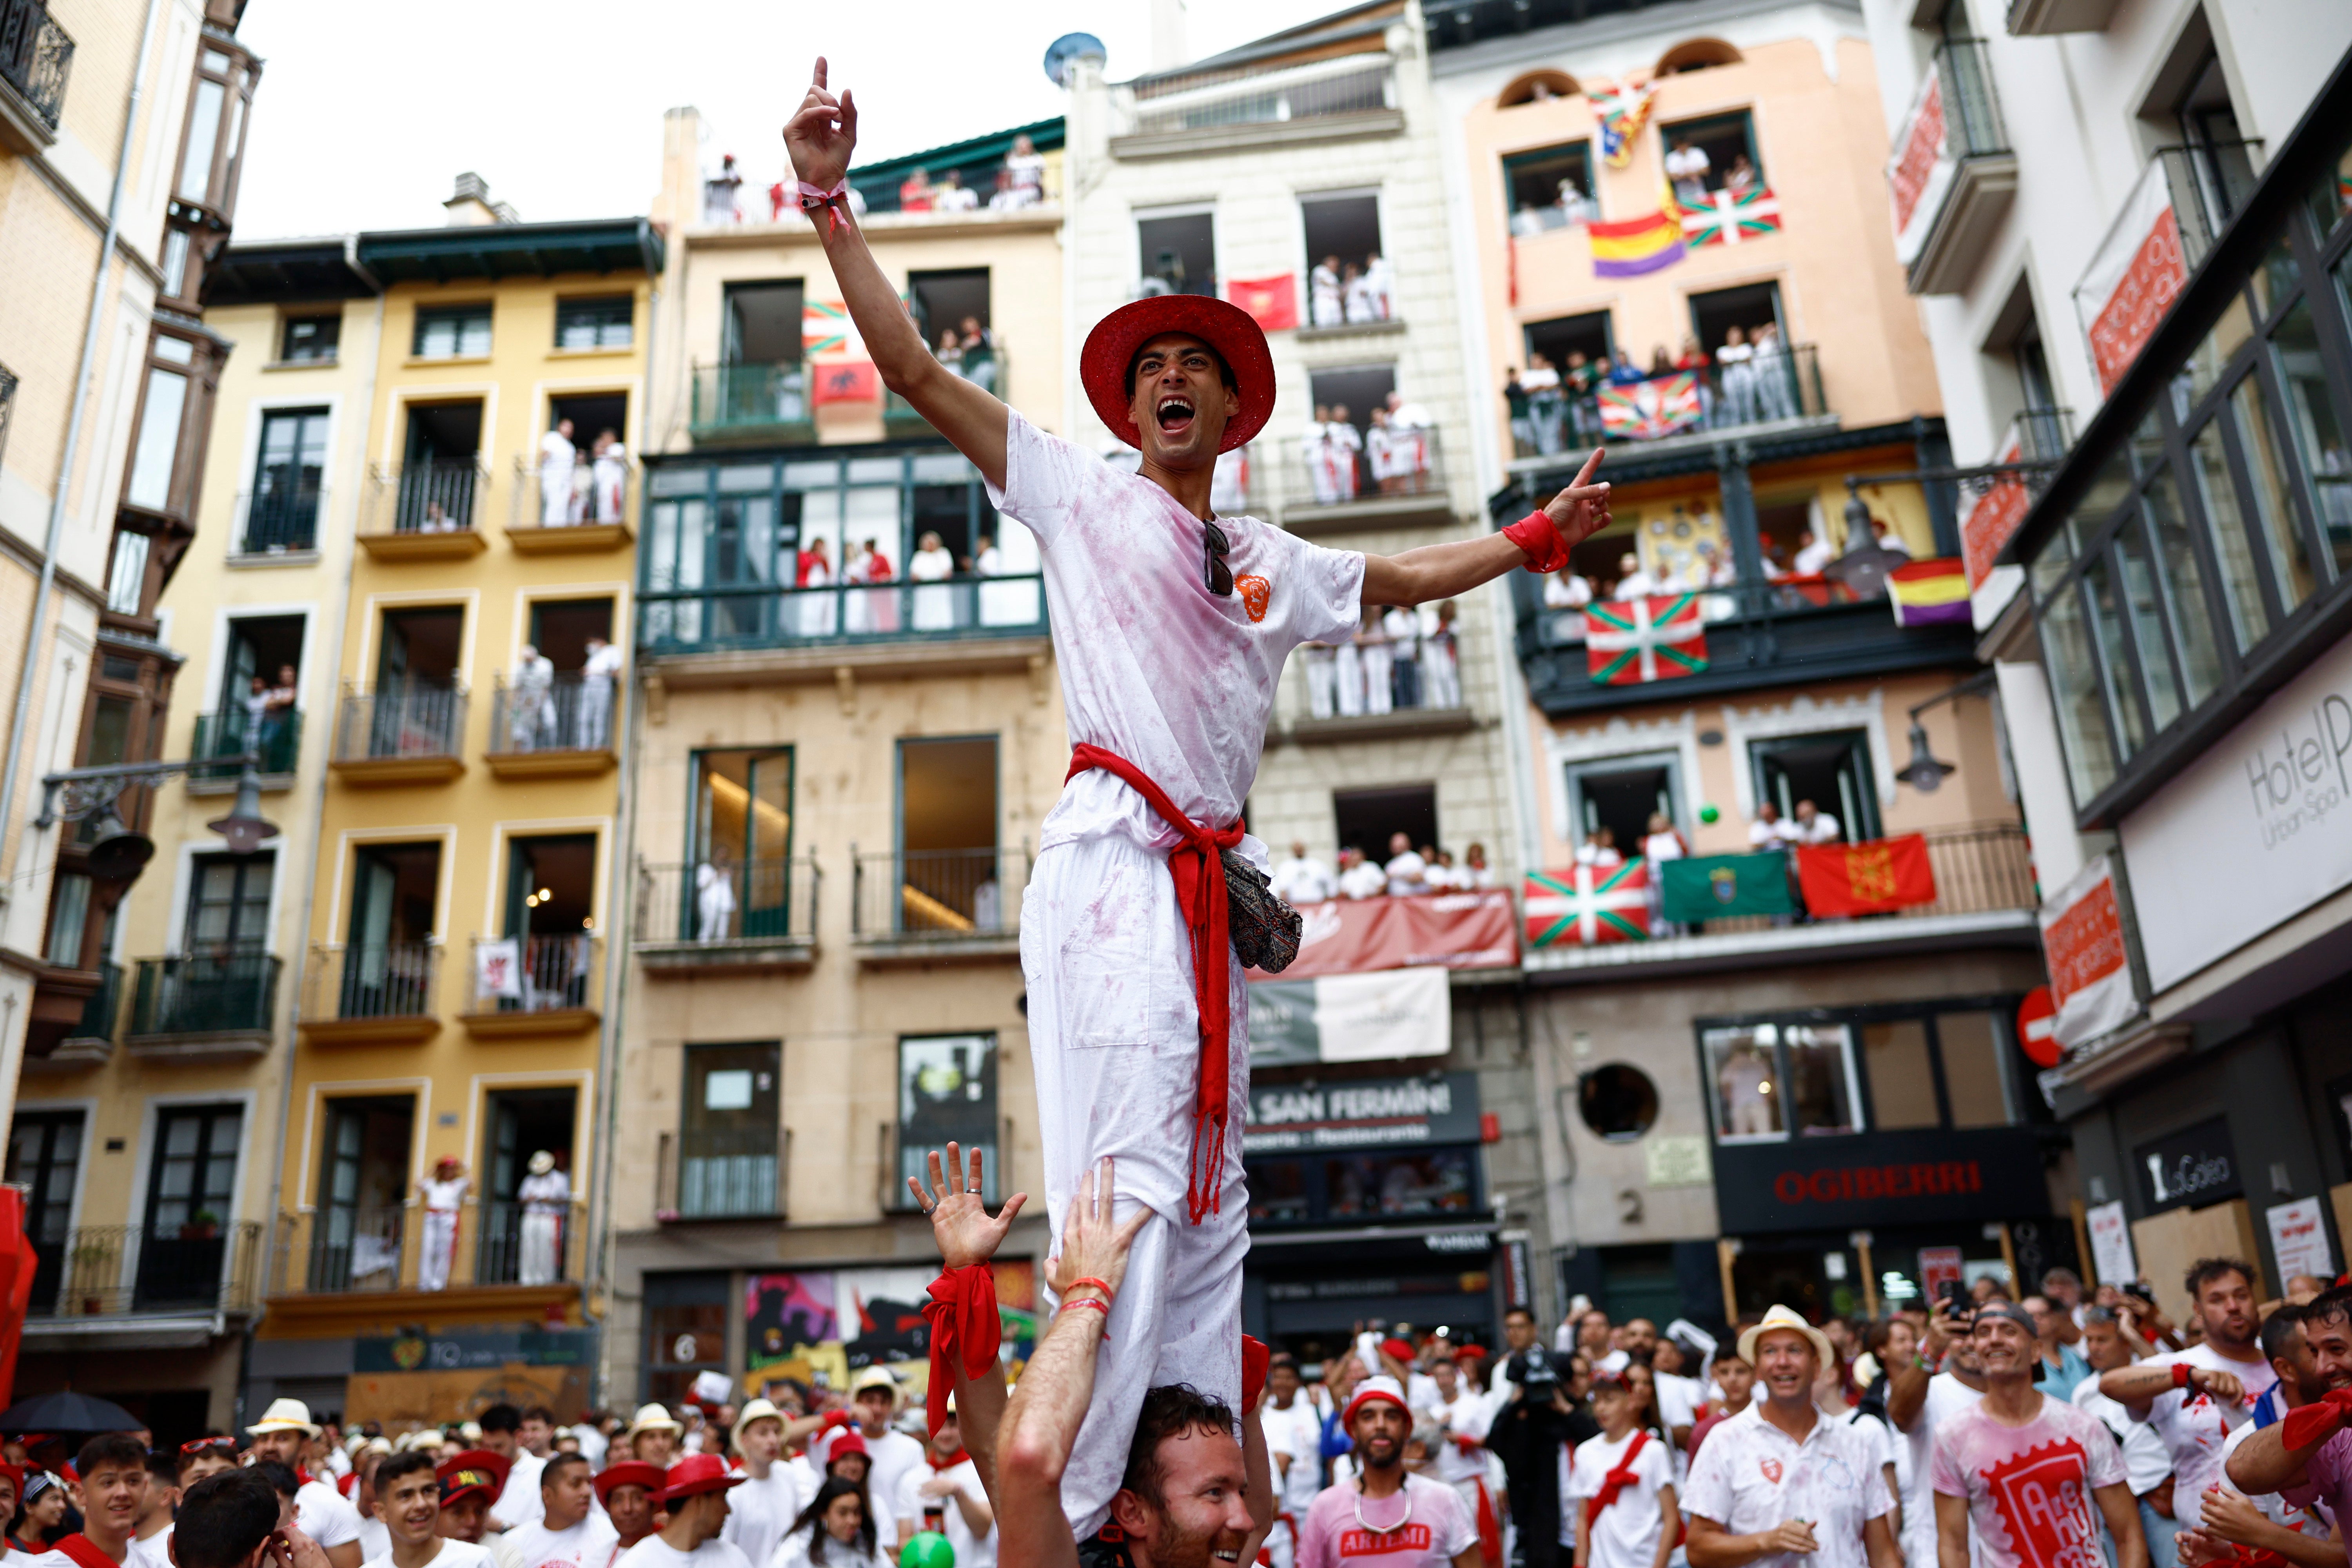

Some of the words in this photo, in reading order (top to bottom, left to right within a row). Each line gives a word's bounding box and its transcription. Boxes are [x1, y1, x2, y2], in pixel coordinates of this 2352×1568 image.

[1240, 578, 1268, 592] FIESTA
[1259, 1092, 1326, 1126] SAN
[1312, 1123, 1432, 1147] Restaurante
[1774, 1160, 1982, 1205] OGIBERRI
[1619, 1189, 1644, 1225] 2
[673, 1334, 697, 1363] 6
[1343, 1527, 1426, 1552] ARTEMI
